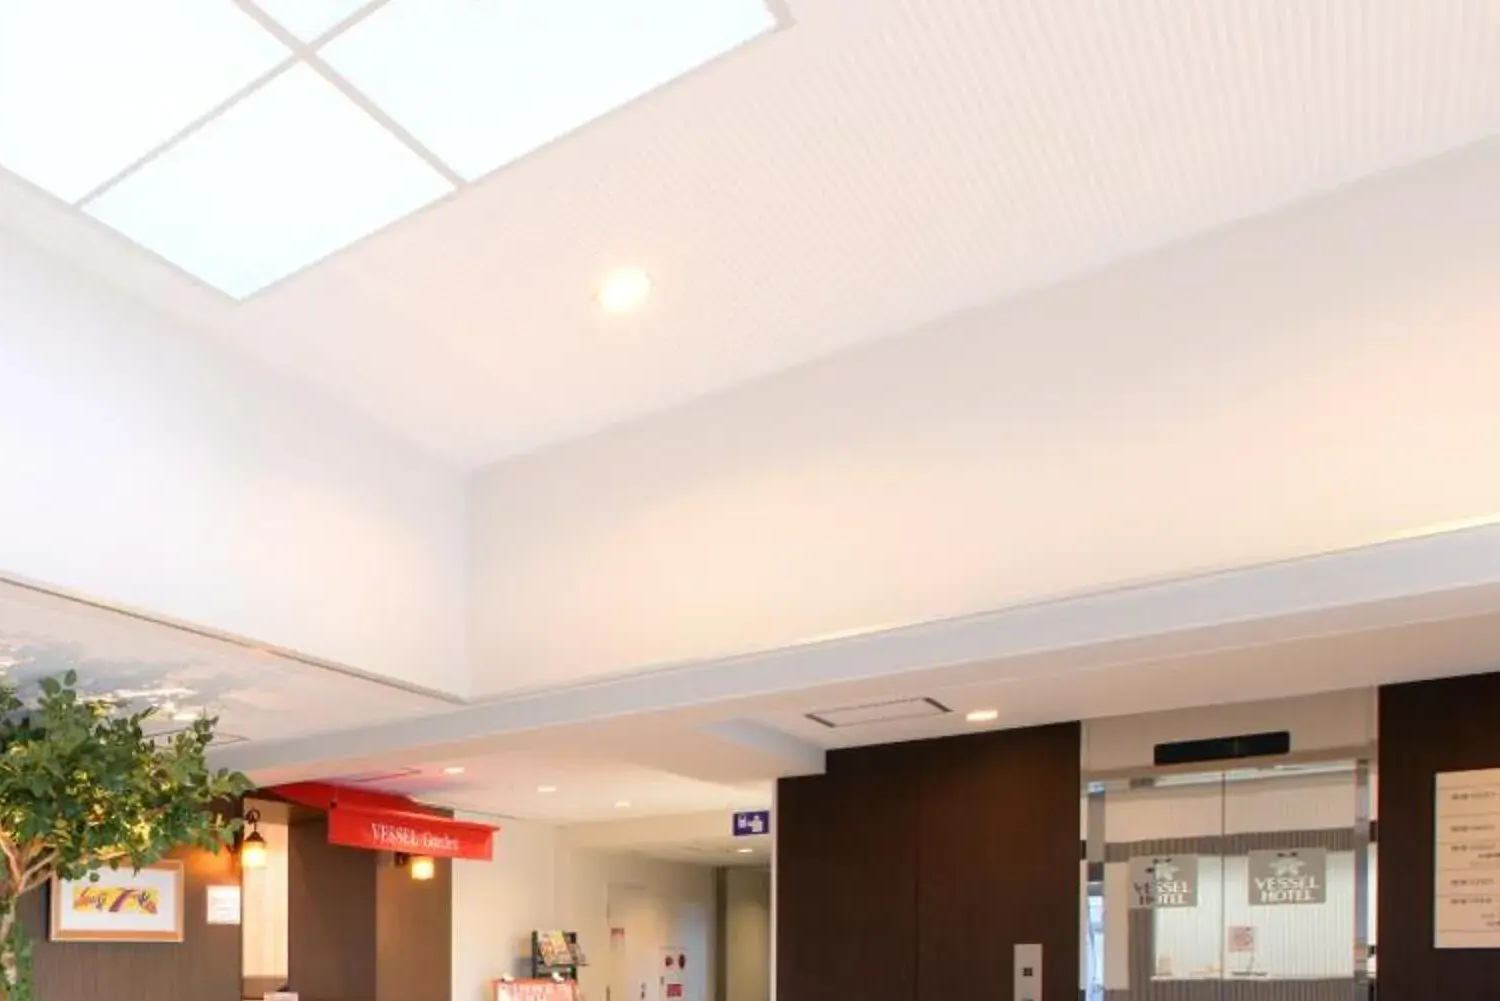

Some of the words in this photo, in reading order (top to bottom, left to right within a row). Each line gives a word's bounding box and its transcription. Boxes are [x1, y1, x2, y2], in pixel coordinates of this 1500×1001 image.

[371, 823, 418, 846] VESSEL
[1254, 876, 1320, 890] VESSEL
[1261, 888, 1314, 902] HOTEL
